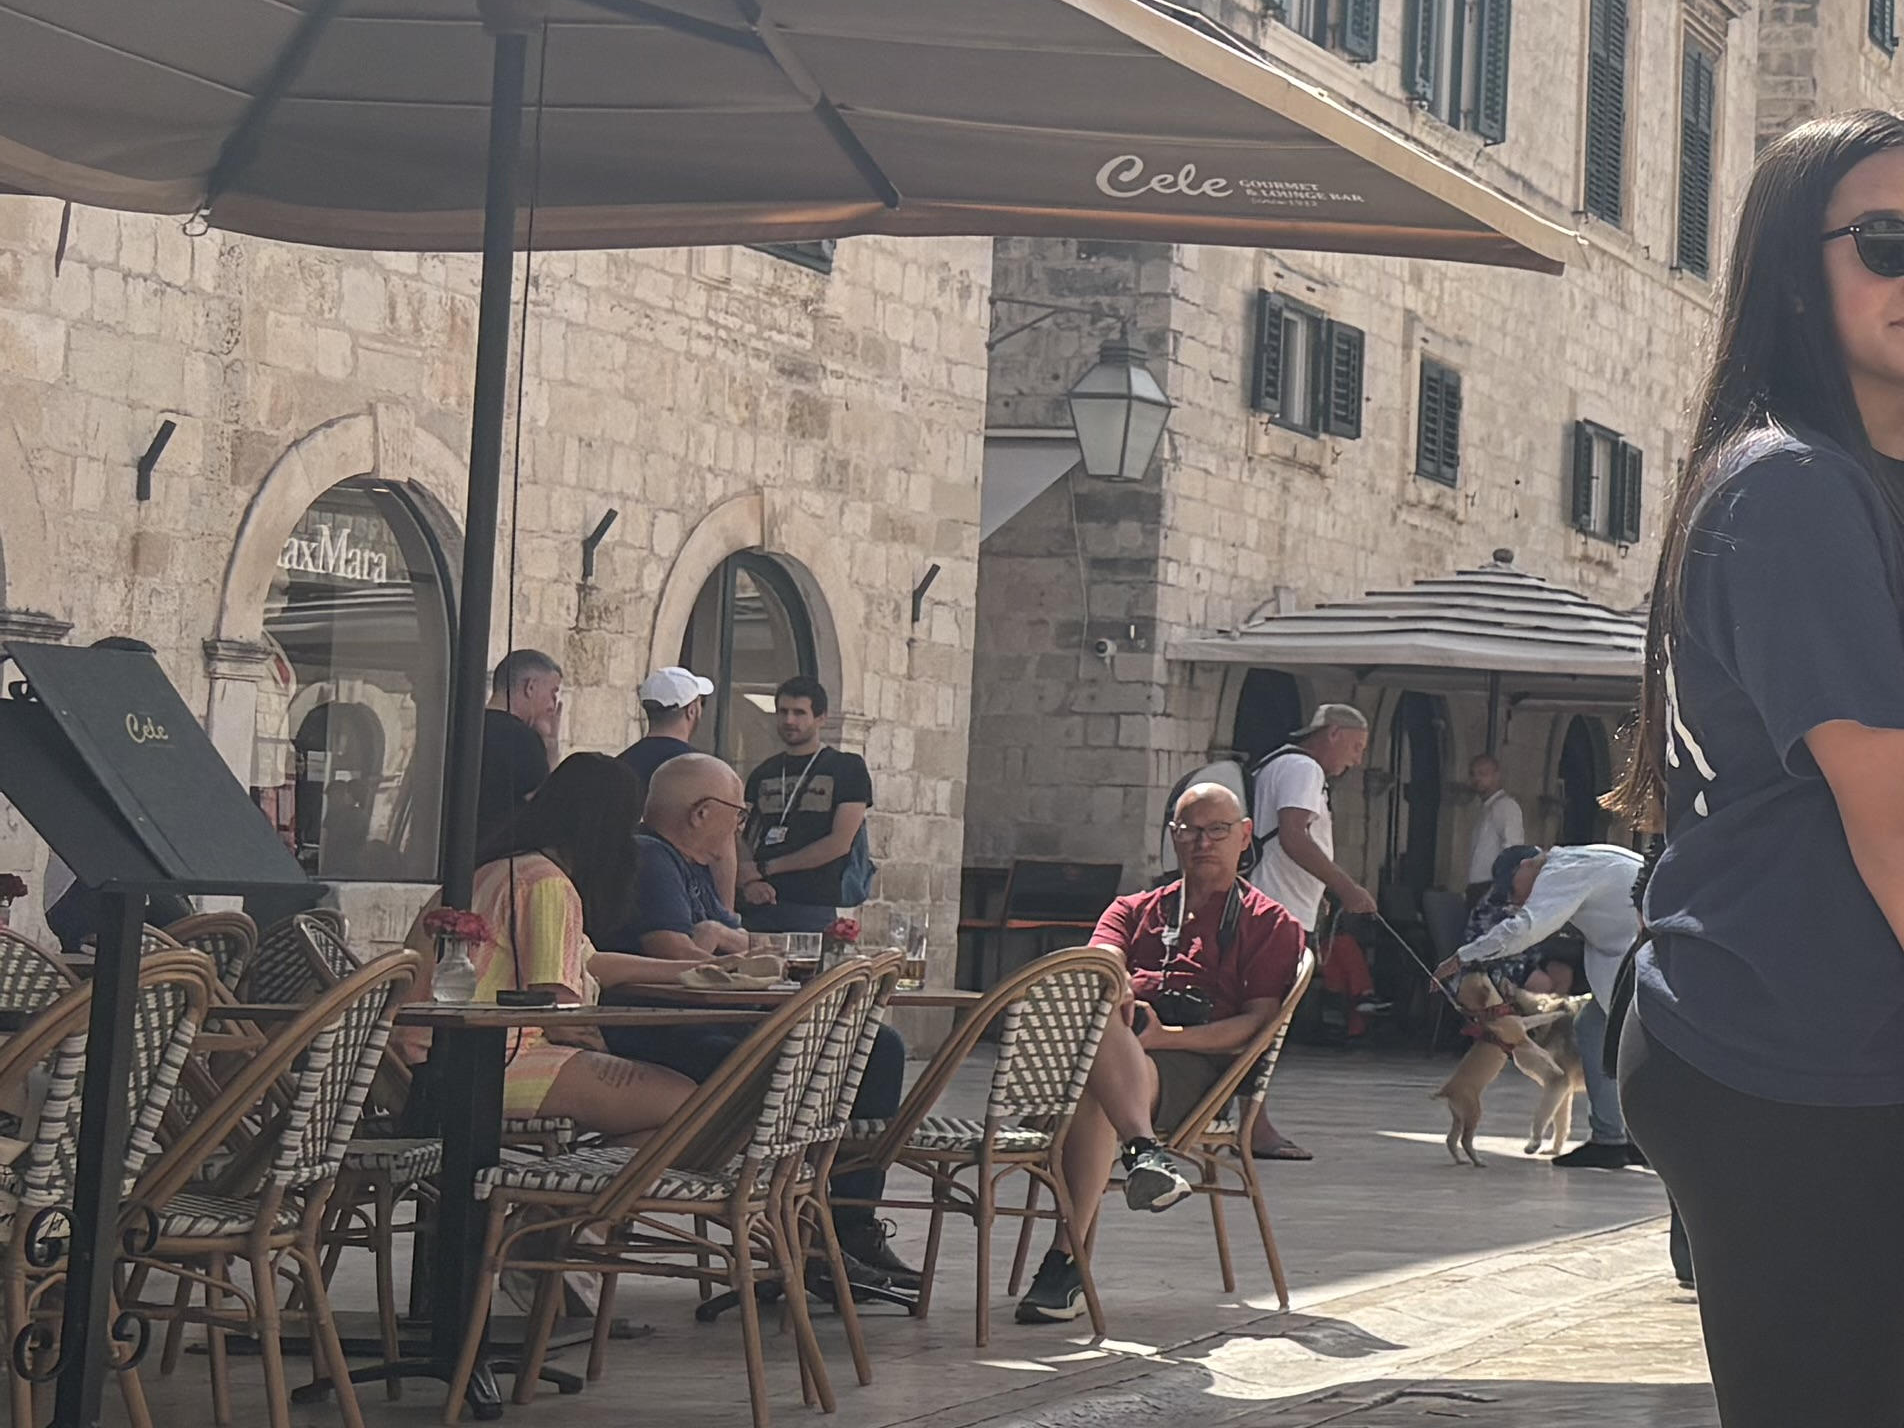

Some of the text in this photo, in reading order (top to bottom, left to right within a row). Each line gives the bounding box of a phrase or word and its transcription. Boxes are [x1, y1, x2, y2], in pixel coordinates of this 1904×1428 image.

[1095, 155, 1233, 198] Cele
[1239, 179, 1319, 191] GOURMET
[1260, 189, 1327, 201] LOUNGE
[1329, 193, 1365, 203] BAR
[277, 524, 387, 583] axMara
[125, 713, 169, 743] Cele
